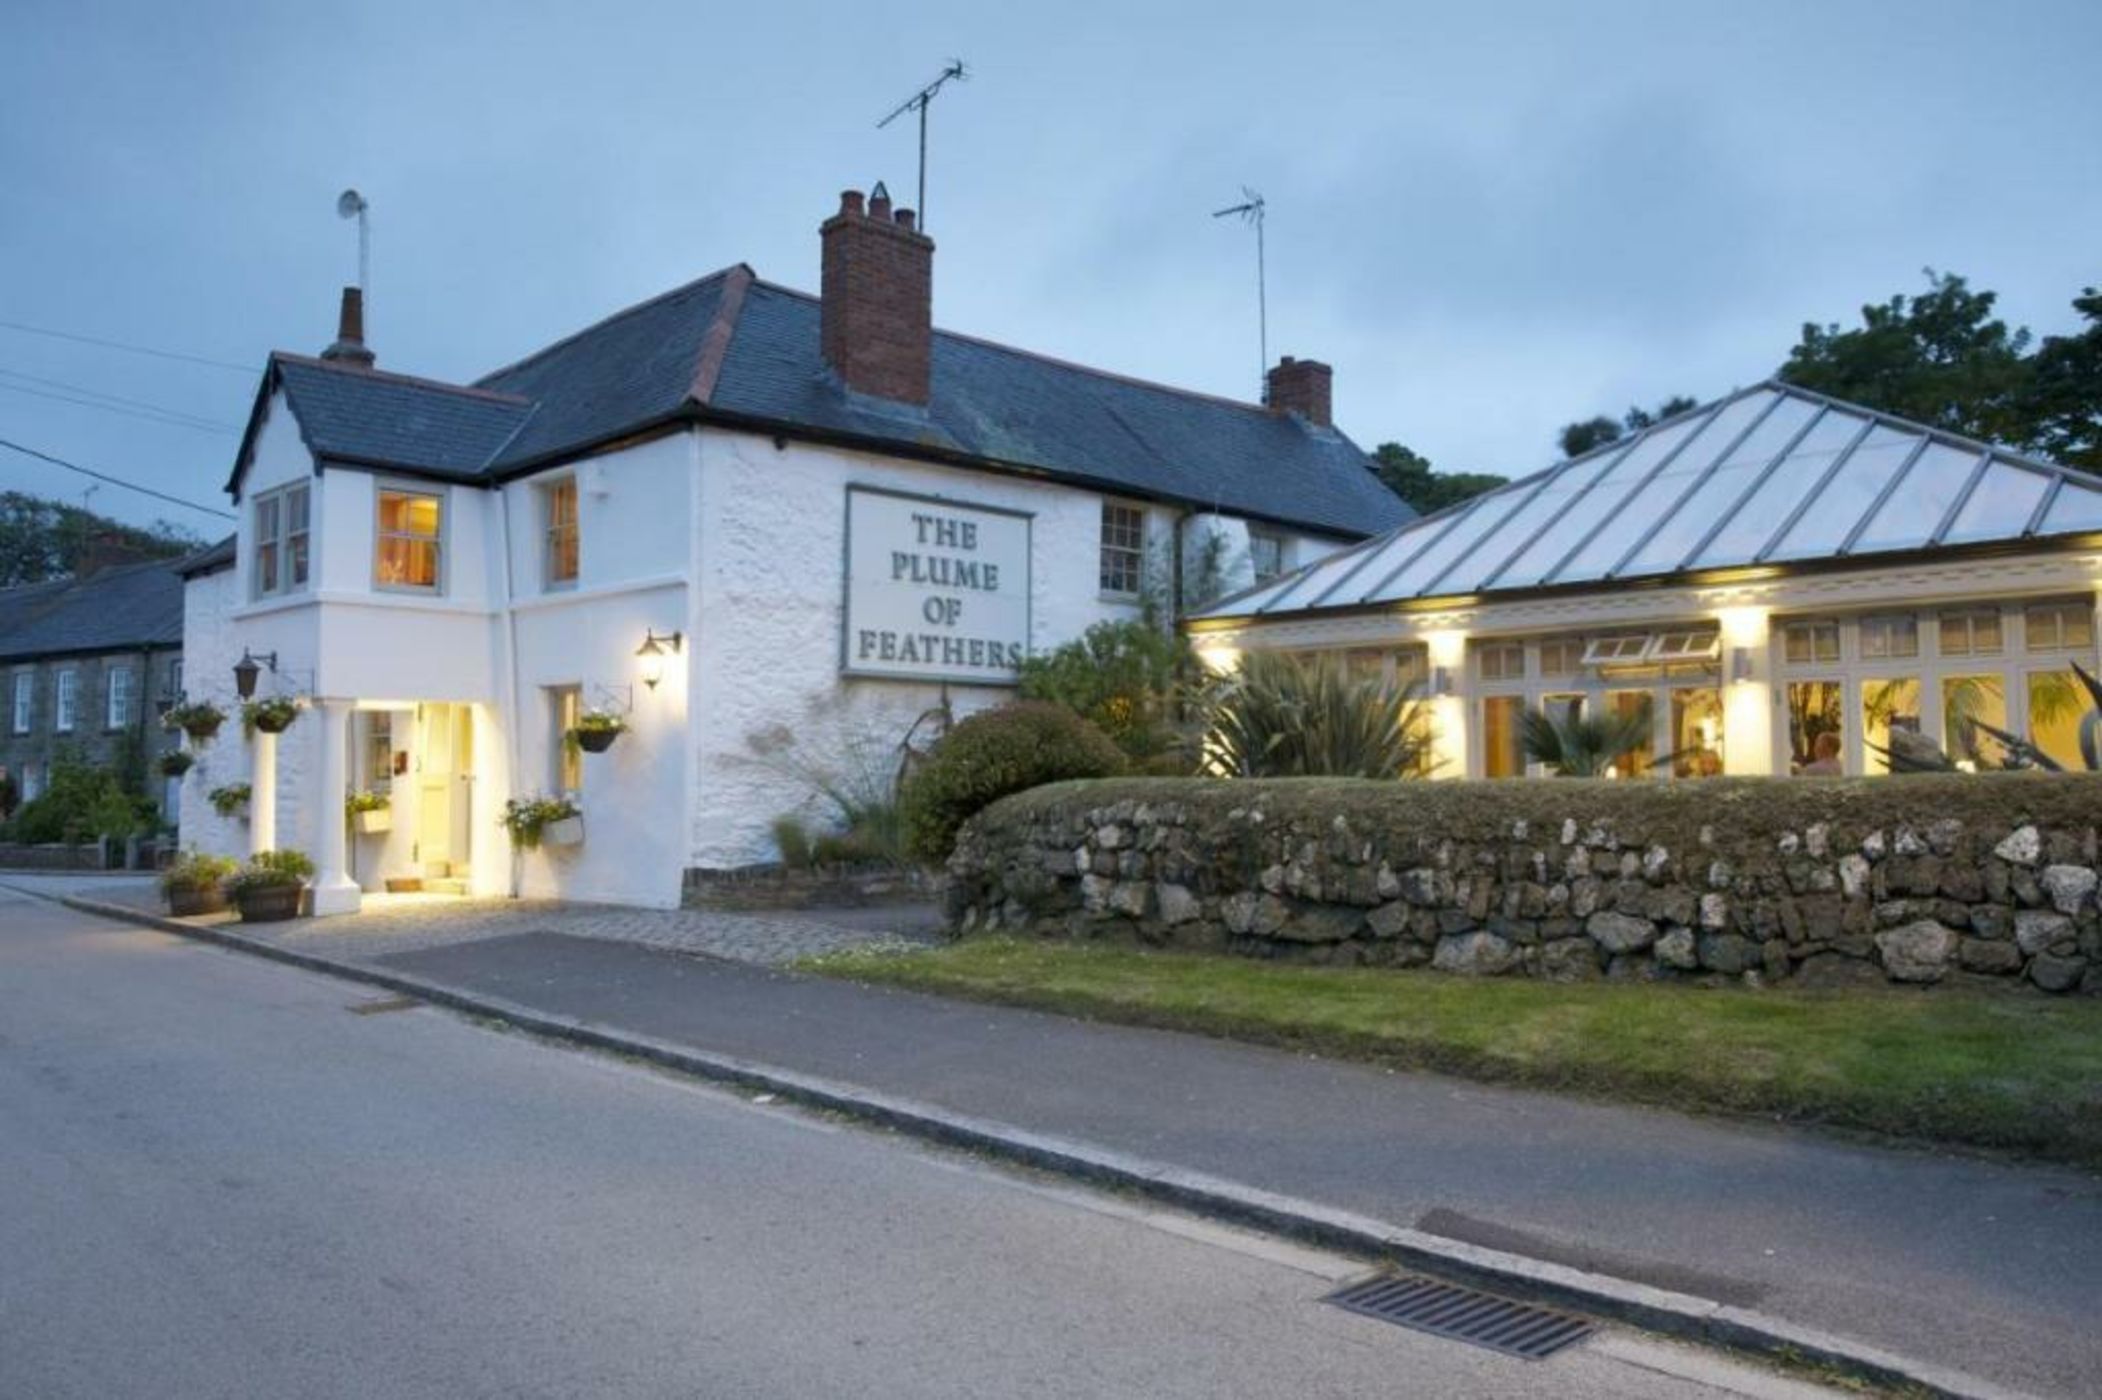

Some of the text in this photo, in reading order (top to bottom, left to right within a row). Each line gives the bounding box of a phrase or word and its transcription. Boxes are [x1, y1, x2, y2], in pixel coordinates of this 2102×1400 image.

[911, 513, 977, 549] THE
[891, 551, 998, 591] PLUME
[923, 596, 961, 626] OF
[858, 629, 1023, 669] FEATHERS
